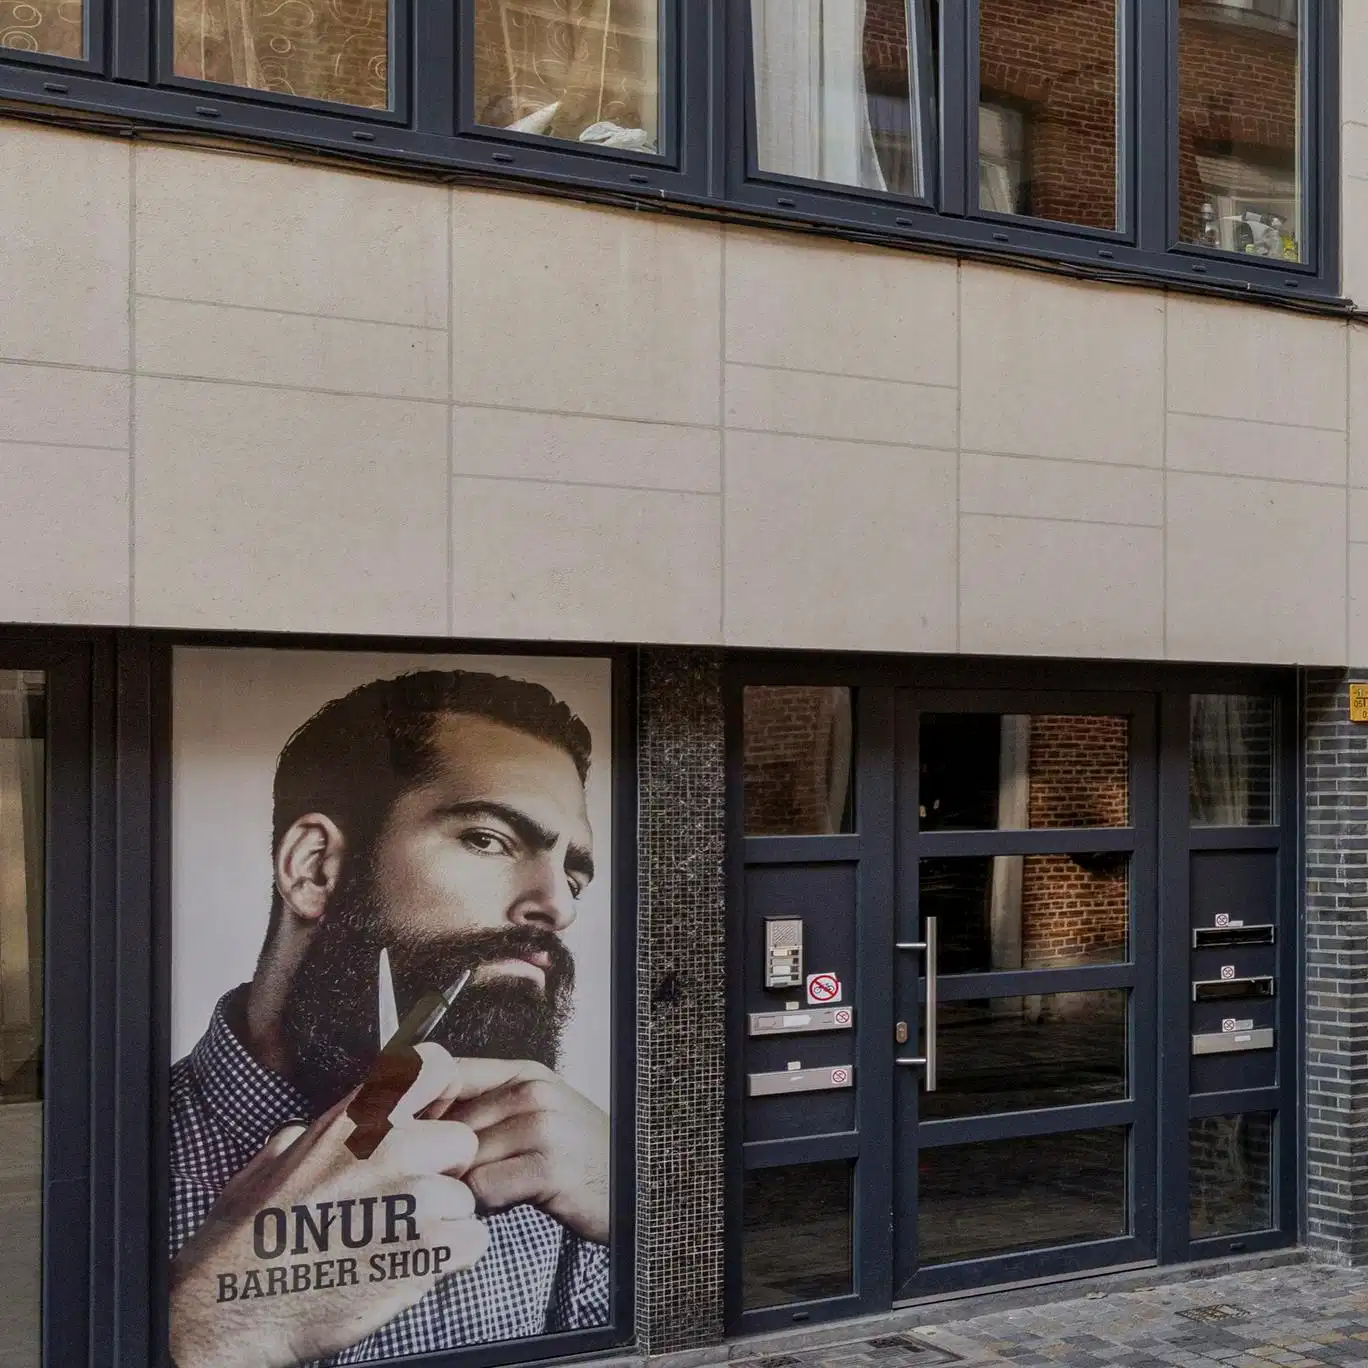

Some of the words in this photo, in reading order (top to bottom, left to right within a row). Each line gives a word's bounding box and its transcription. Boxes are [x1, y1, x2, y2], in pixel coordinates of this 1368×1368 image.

[253, 1193, 421, 1260] ONUR
[216, 1257, 360, 1304] BARBER
[368, 1245, 452, 1283] SHOP
